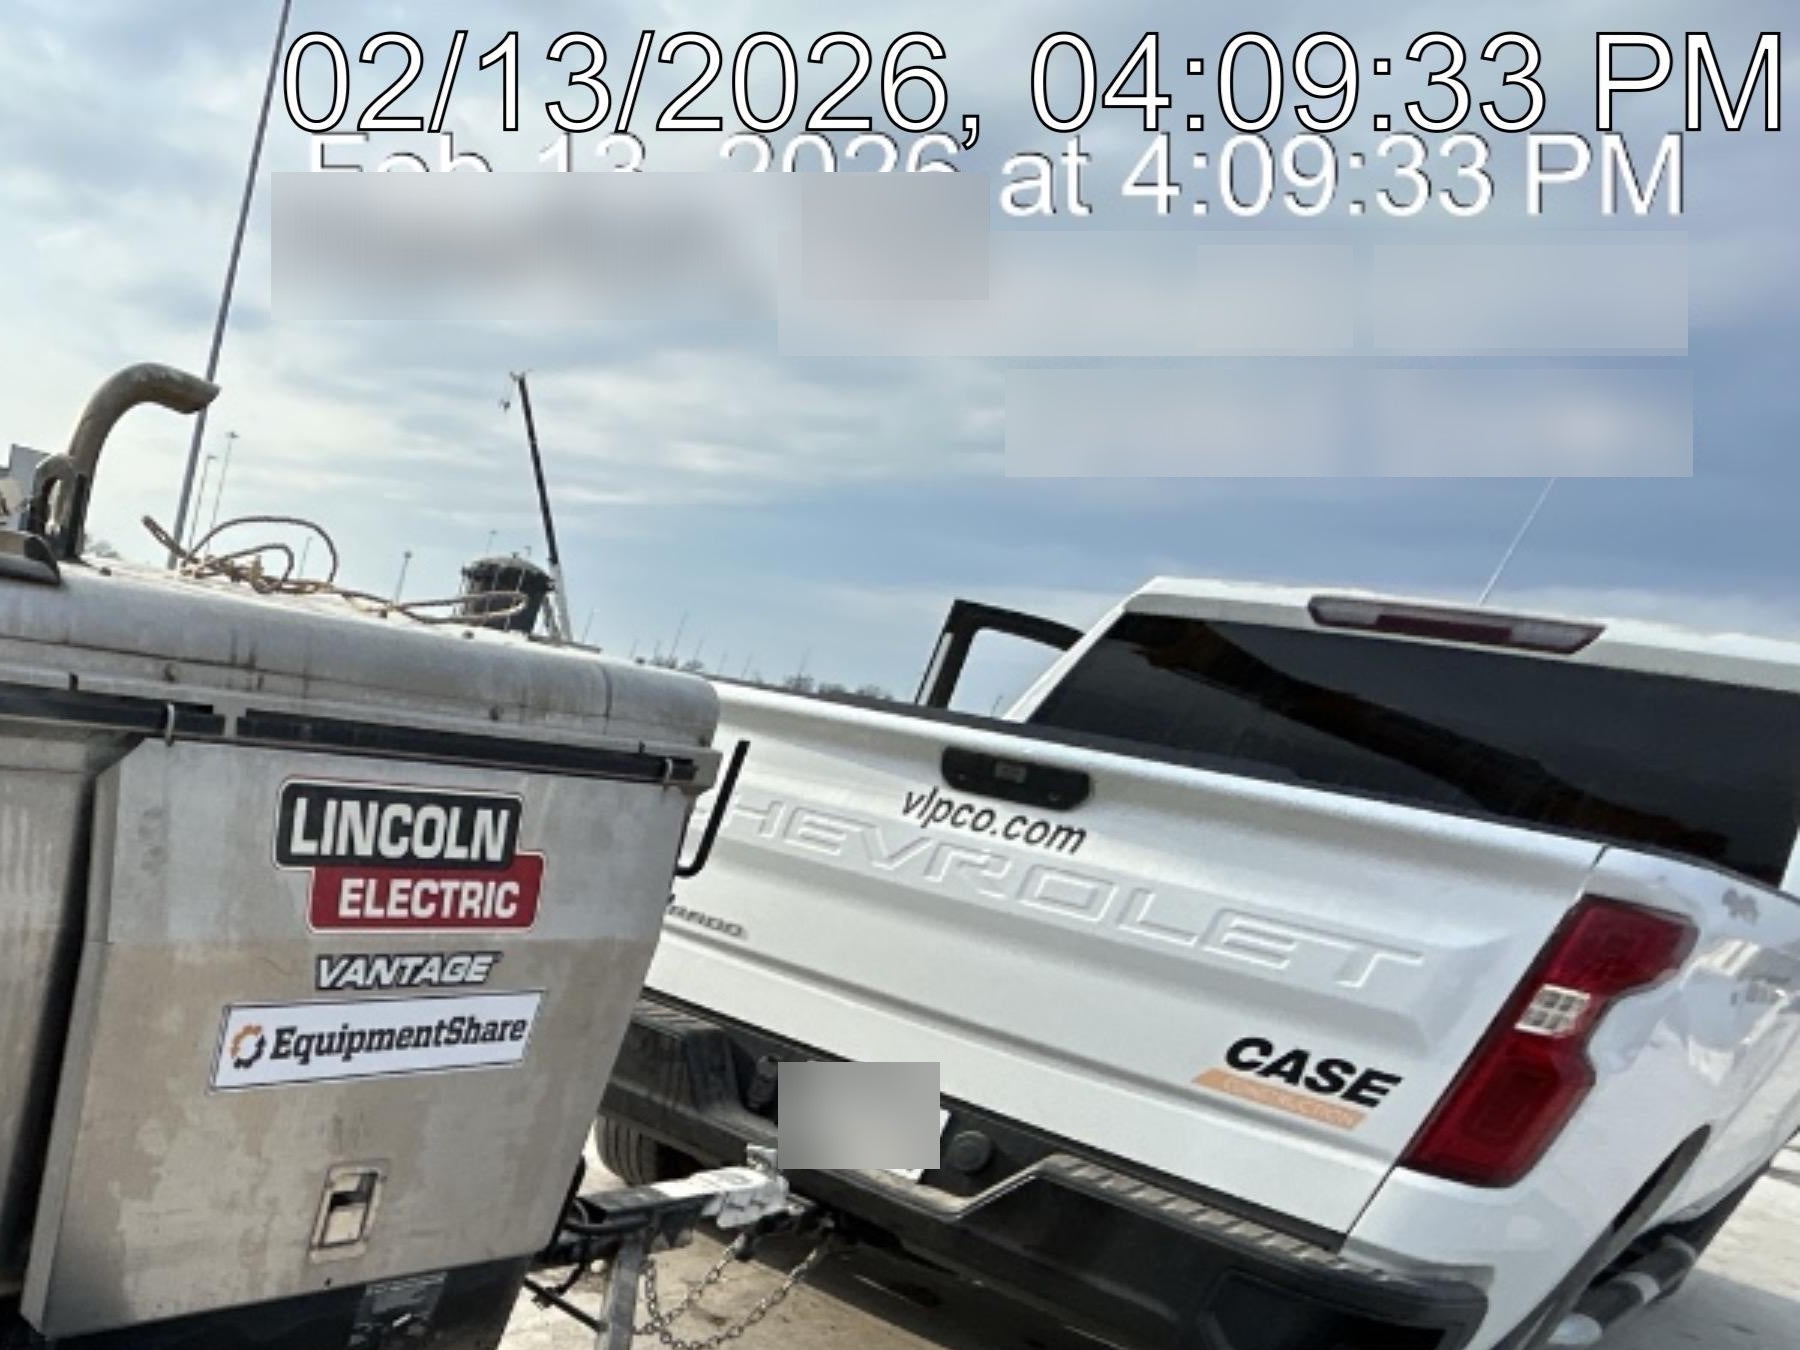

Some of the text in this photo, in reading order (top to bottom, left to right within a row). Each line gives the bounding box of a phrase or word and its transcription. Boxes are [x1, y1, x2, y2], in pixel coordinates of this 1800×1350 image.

[290, 797, 509, 862] LINCOLN
[902, 786, 1087, 854] vlpco.com
[338, 878, 520, 920] ELECTRIC
[705, 798, 1427, 990] HEVROLET
[317, 954, 496, 989] VANTAGE
[269, 1014, 527, 1066] EquipmentShare
[1225, 1036, 1403, 1109] CASE
